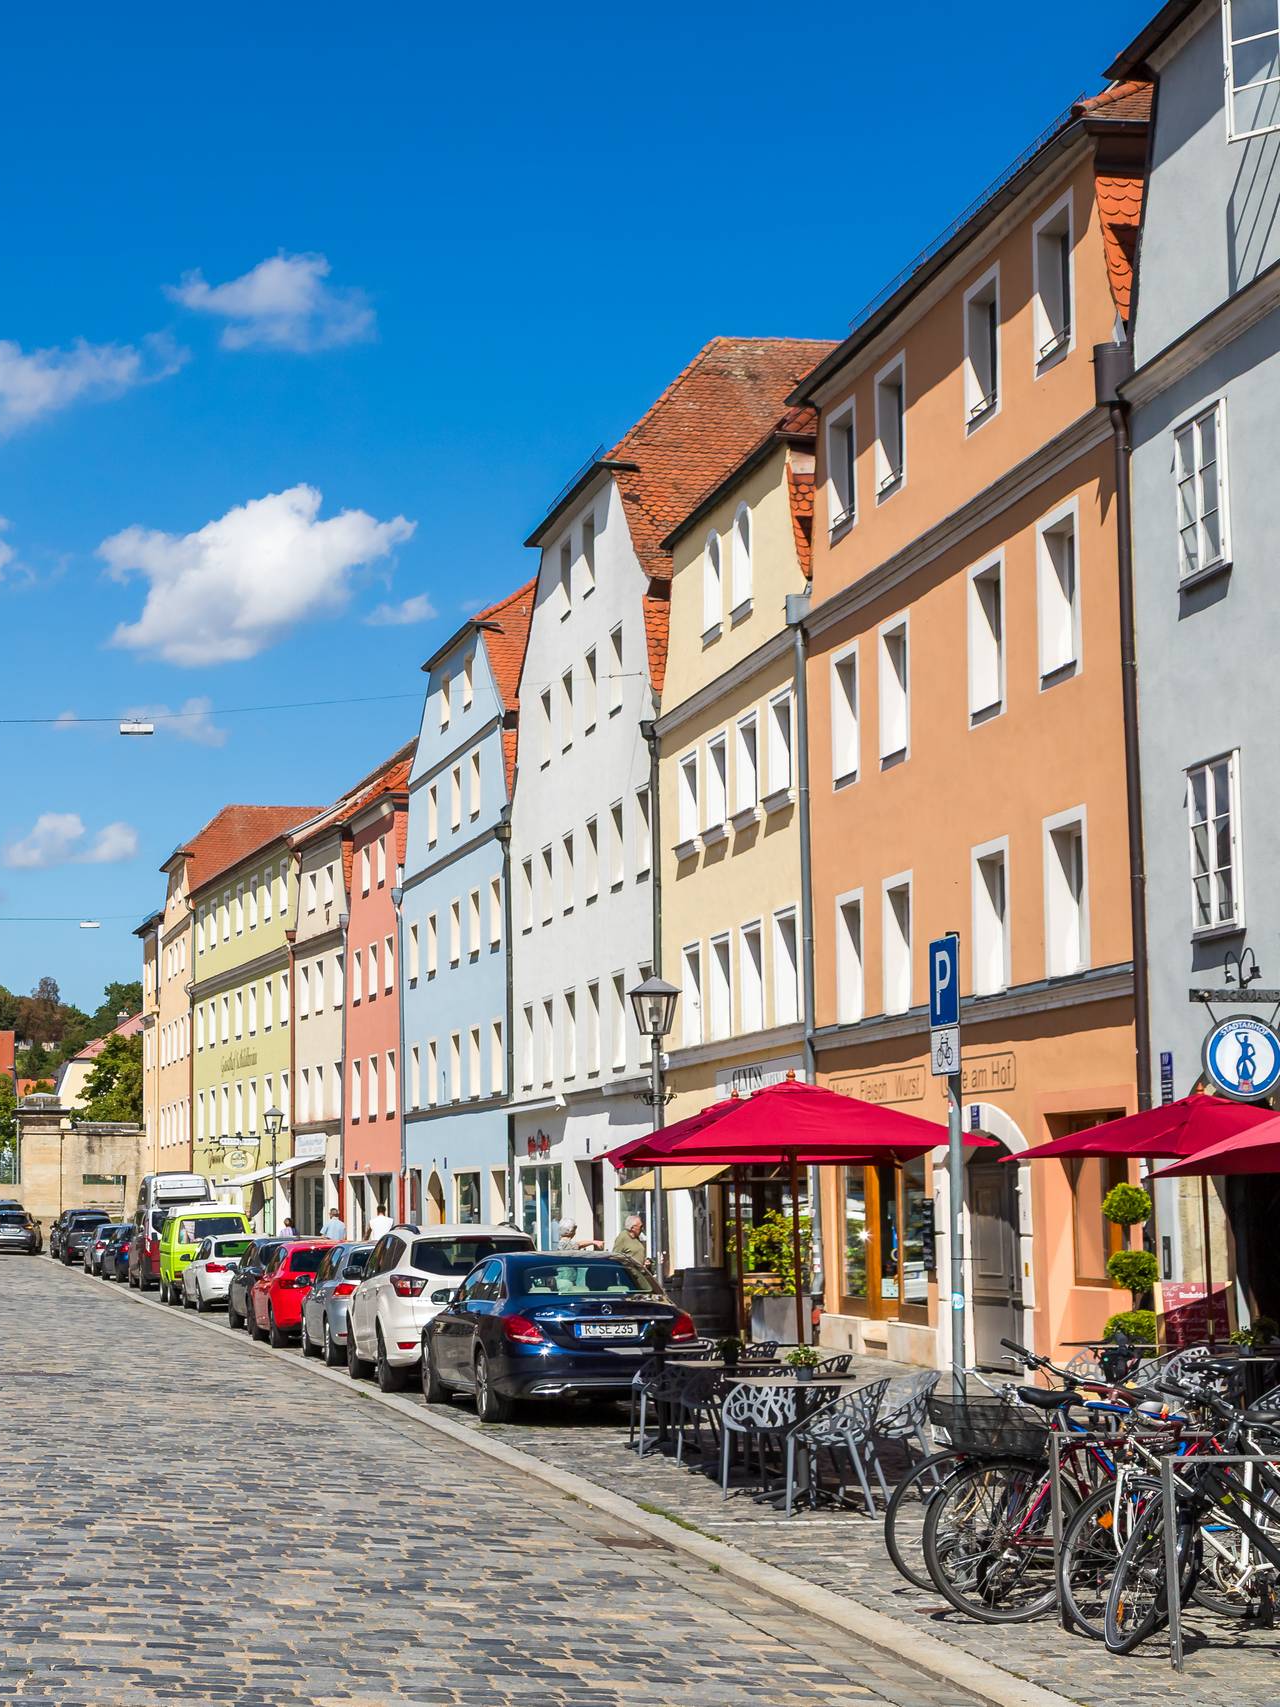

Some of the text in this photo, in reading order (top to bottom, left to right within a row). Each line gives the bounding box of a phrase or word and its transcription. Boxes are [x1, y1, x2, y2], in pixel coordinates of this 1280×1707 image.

[935, 950, 951, 1016] P
[1220, 1021, 1269, 1036] STADTAMHOF
[895, 1073, 920, 1097] Wurst
[971, 1068, 987, 1088] am
[991, 1060, 1011, 1086] Hof
[585, 1324, 634, 1335] R SE 235
